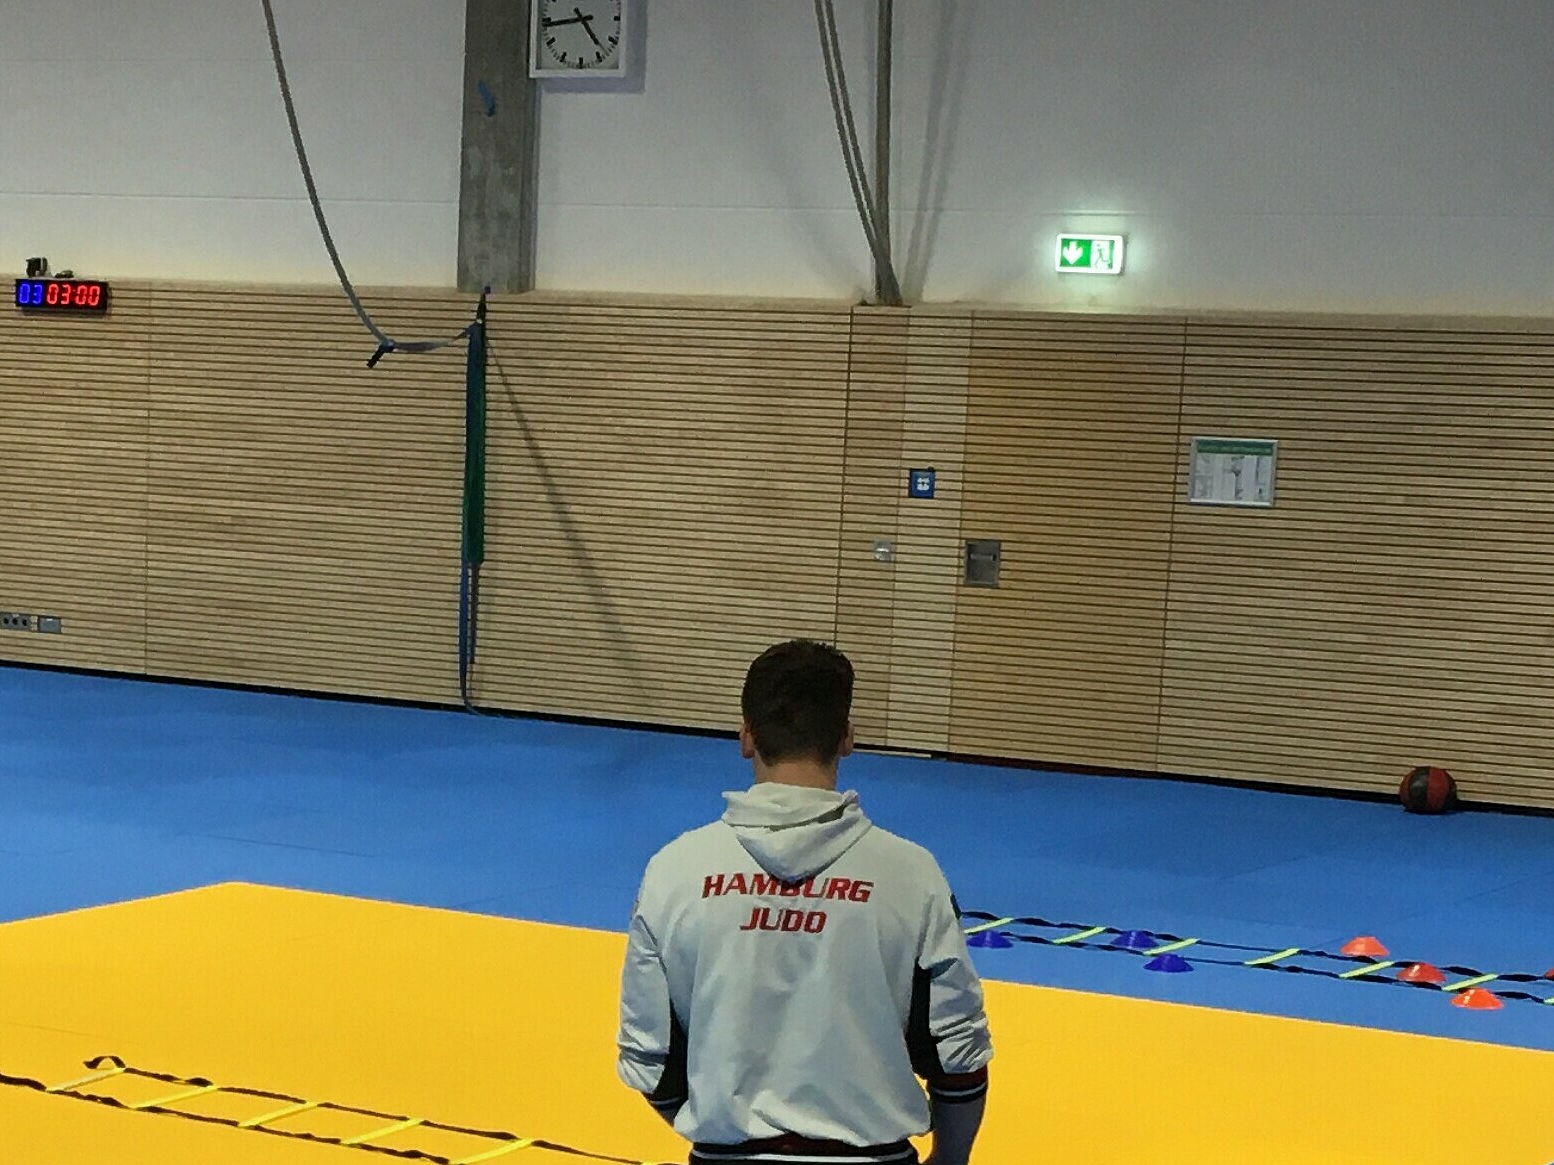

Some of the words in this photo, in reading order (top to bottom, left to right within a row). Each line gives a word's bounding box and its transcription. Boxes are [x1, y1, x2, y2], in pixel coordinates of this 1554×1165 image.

[19, 283, 43, 304] 03
[46, 283, 101, 306] 03:00
[739, 907, 828, 934] JUDO
